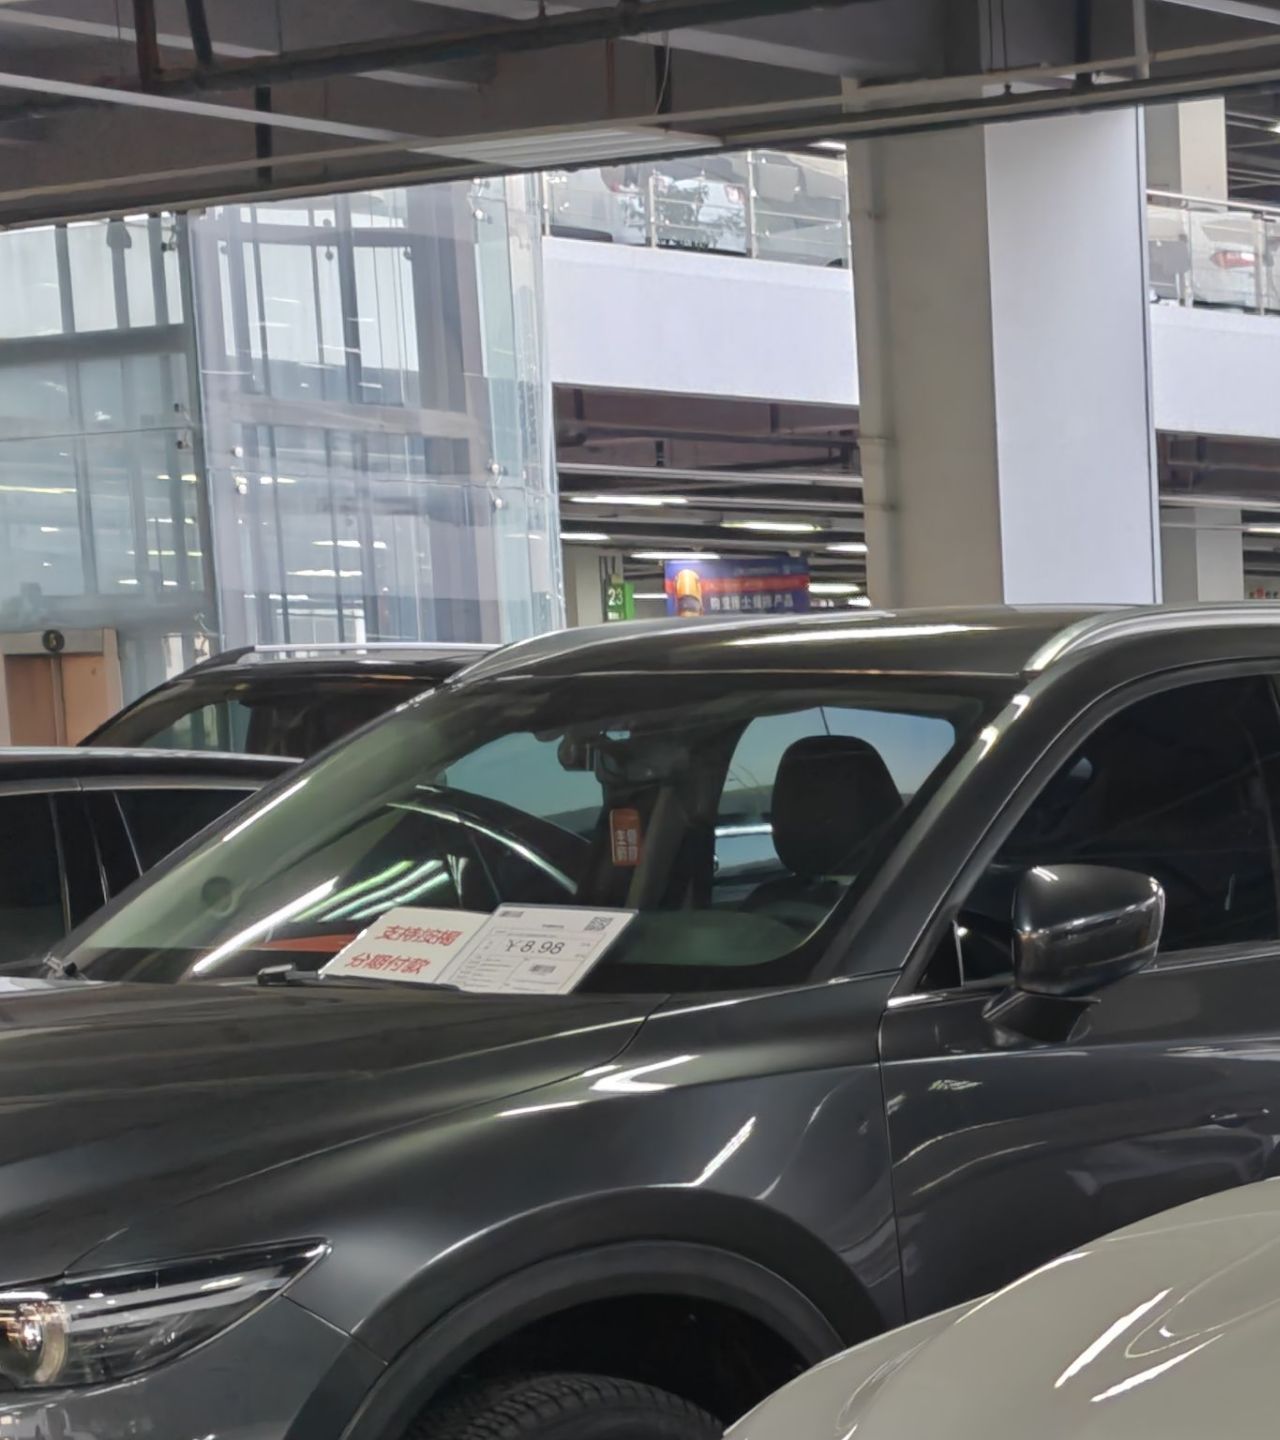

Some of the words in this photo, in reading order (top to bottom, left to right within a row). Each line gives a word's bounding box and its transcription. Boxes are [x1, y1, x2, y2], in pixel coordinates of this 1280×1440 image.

[608, 588, 623, 606] 23
[374, 925, 463, 946] 支持按揭
[345, 953, 431, 975] 分期付款
